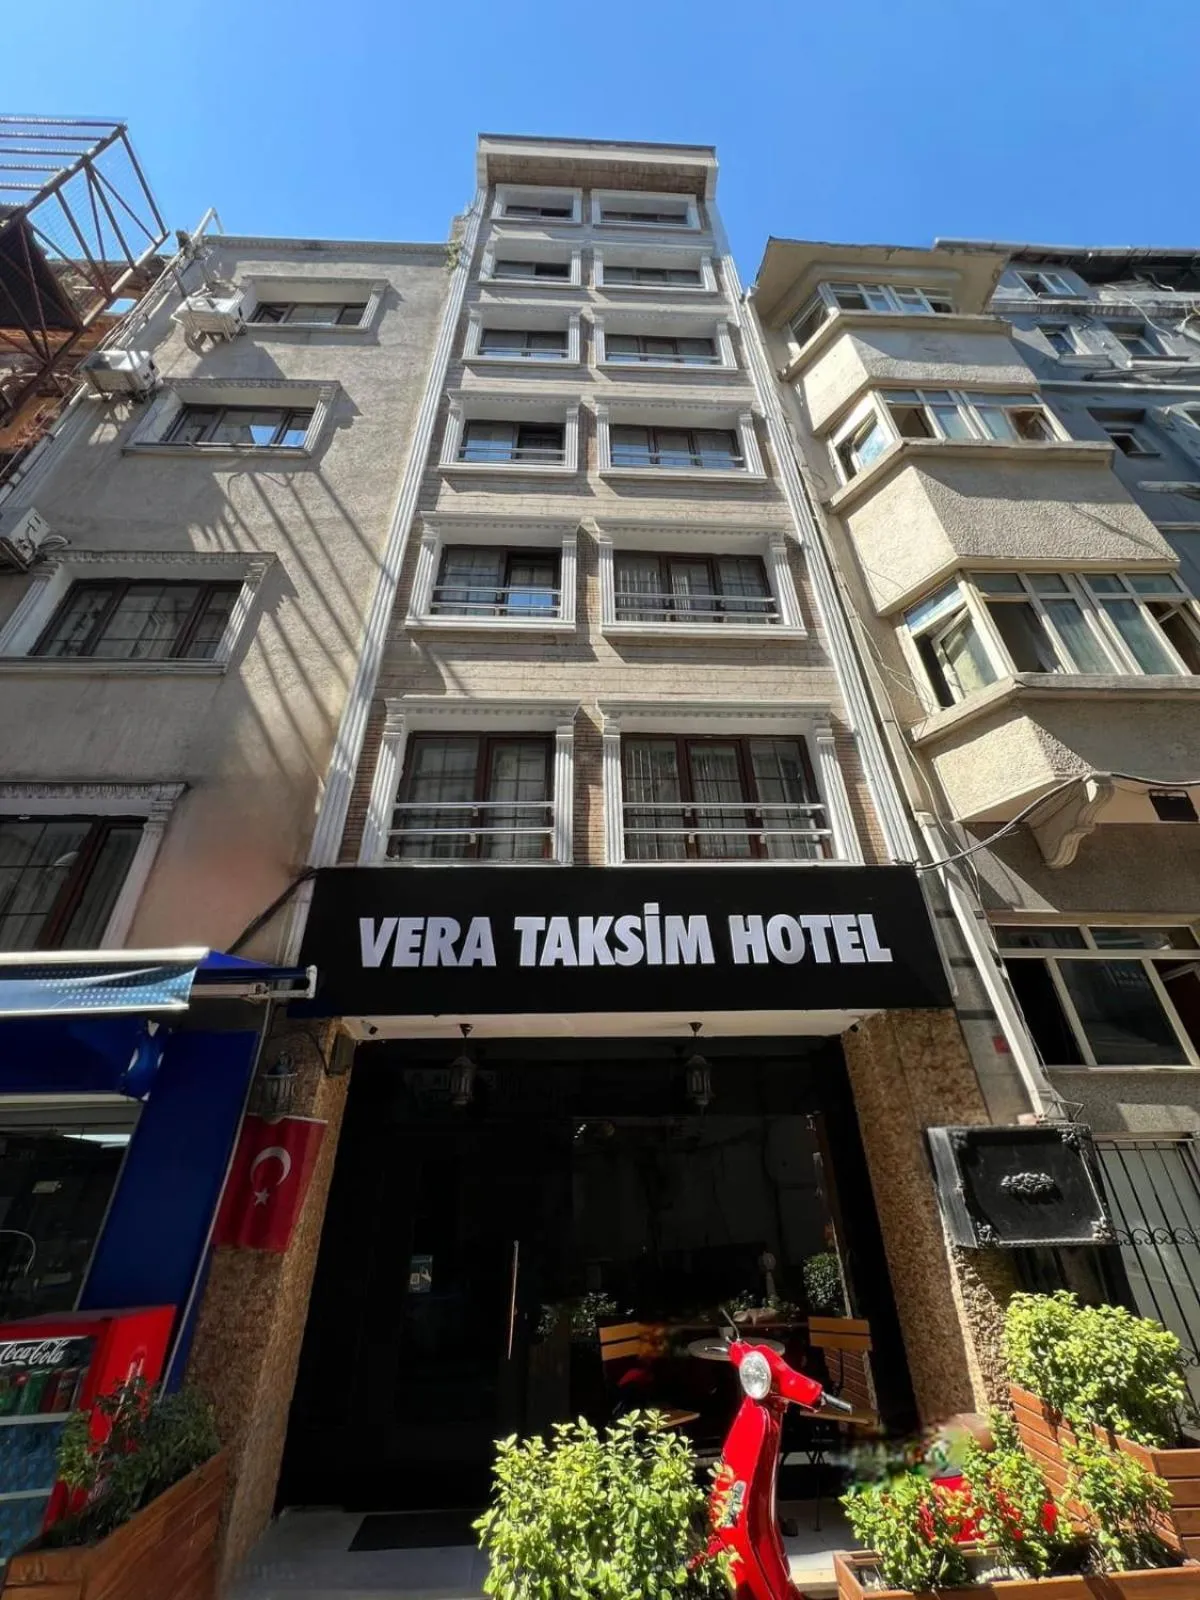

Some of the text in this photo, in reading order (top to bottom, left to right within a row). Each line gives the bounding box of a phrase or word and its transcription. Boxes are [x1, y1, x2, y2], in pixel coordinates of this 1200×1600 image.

[359, 902, 894, 967] VERA TAKSİM HOTEL
